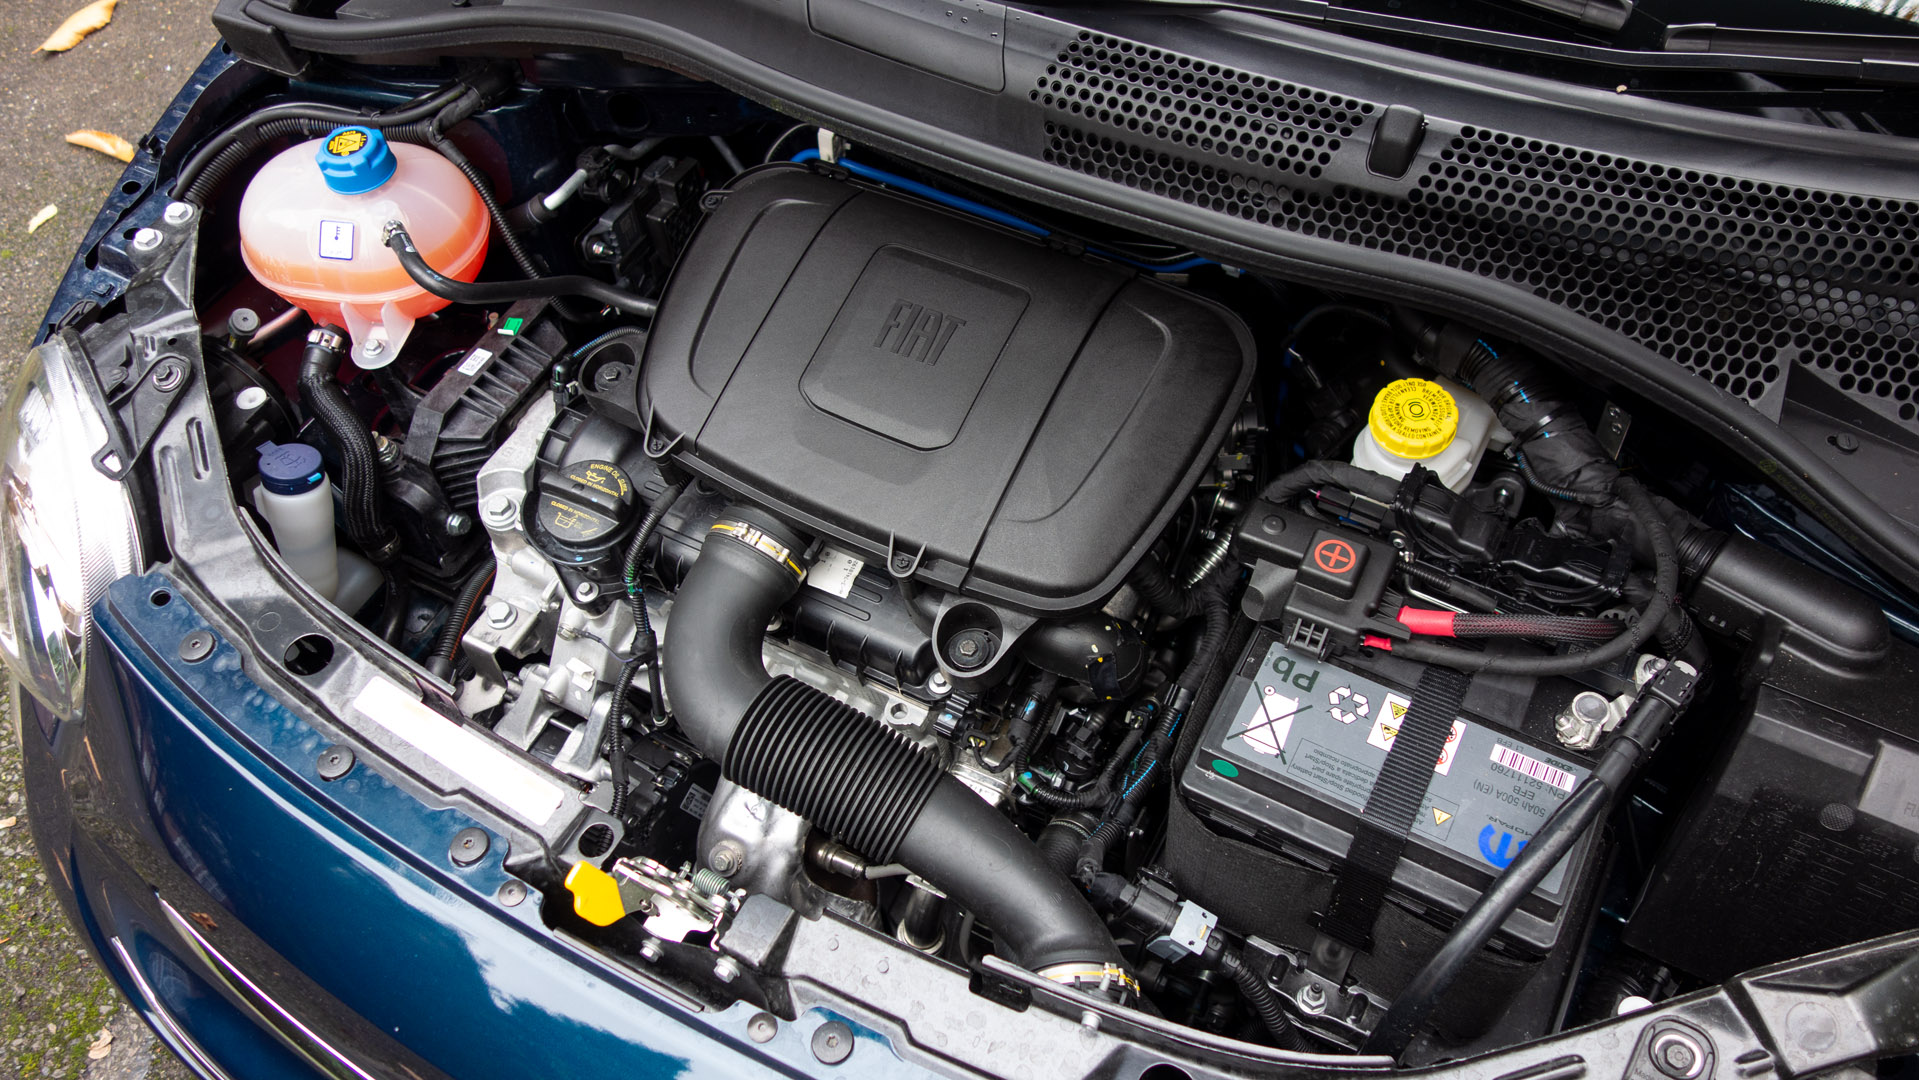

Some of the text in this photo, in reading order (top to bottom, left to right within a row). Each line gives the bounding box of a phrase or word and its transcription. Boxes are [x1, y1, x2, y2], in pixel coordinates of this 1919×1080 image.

[873, 299, 967, 366] FIAT
[1400, 386, 1416, 394] CLEAN
[1404, 425, 1431, 434] REMOVING
[1416, 427, 1442, 439] CONTAINER
[590, 463, 620, 480] ENGINE OIL
[570, 474, 588, 486] CLOSED
[592, 483, 619, 498] HORIZONTAL
[551, 500, 568, 510] CLOSED
[1272, 655, 1320, 693] Pb
[1497, 737, 1513, 748] EFB
[1304, 753, 1336, 771] Stop/Start
[1311, 764, 1326, 774] part
[1313, 748, 1376, 779] appropriato ricambio
[1544, 757, 1574, 773] EXIDE
[1290, 763, 1313, 777] battery
[1325, 770, 1342, 781] spare
[1341, 769, 1369, 784] dedicata
[1312, 773, 1344, 791] Stop/Start
[1490, 762, 1567, 800] PN: 52111760
[1473, 778, 1547, 818] 50Ah 500A (EN)
[1512, 785, 1536, 800] EFB
